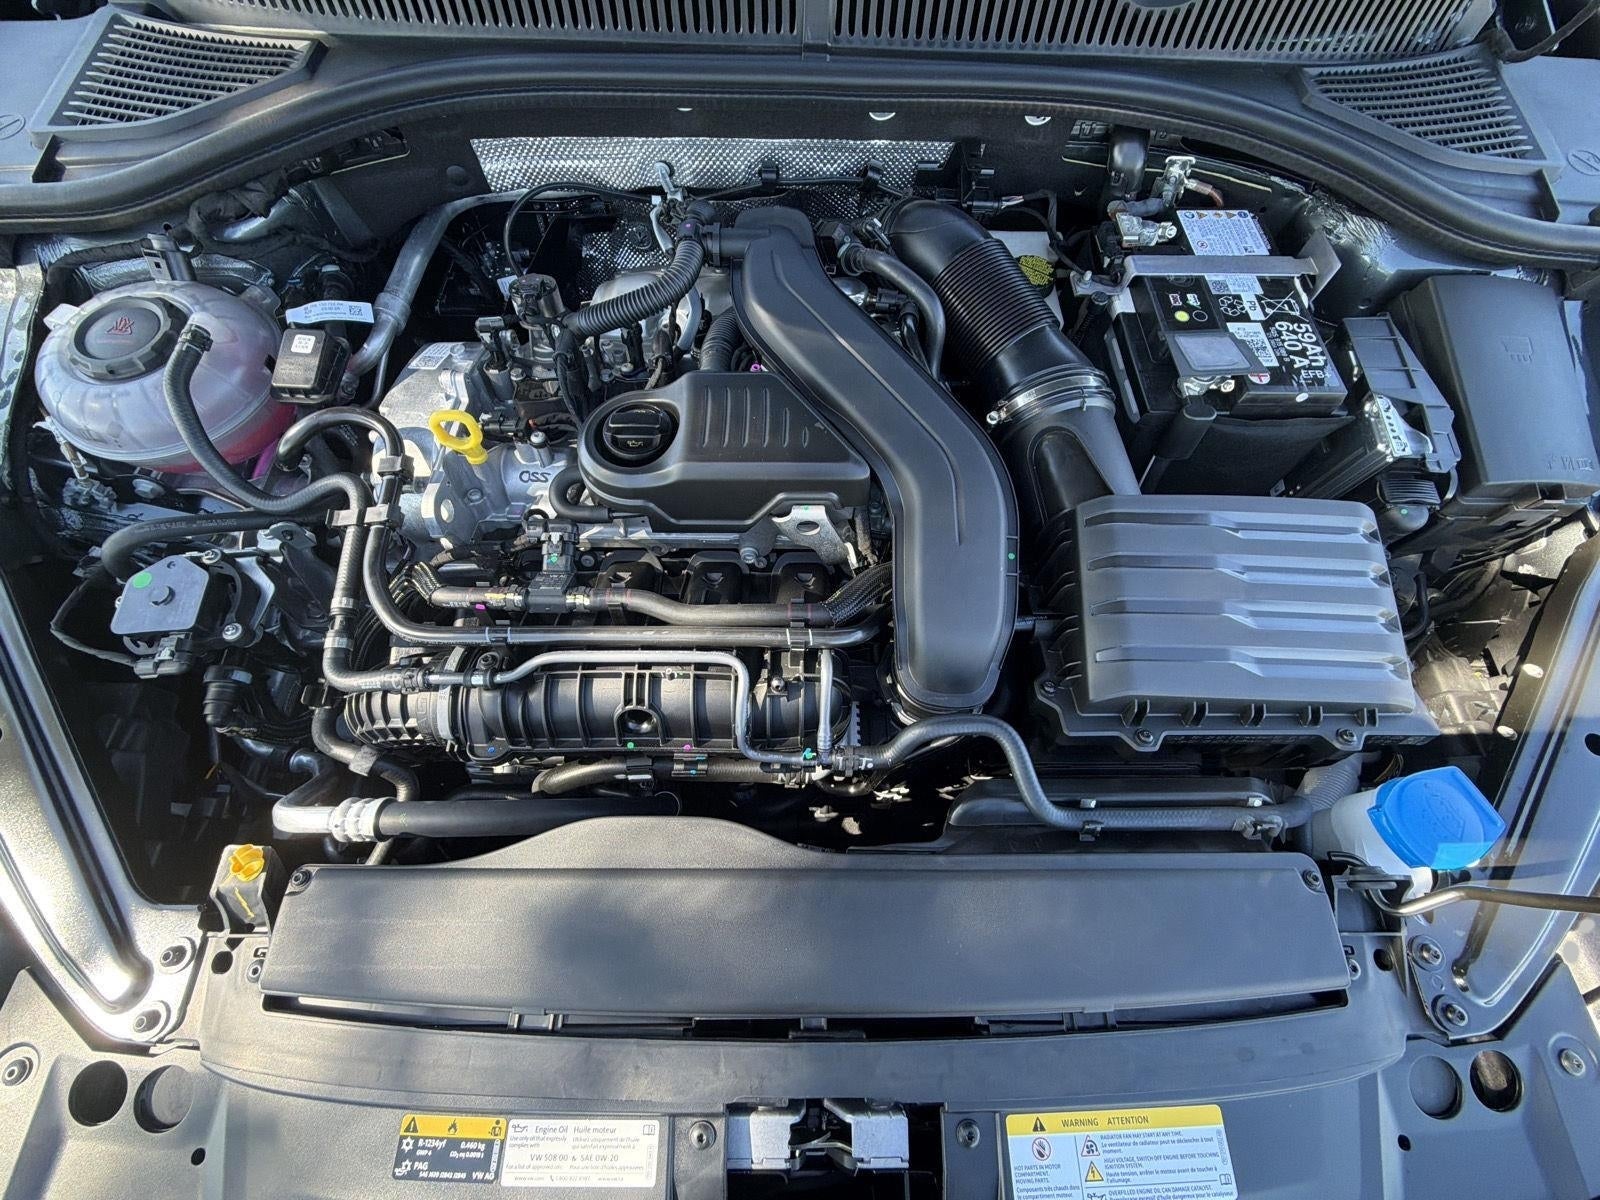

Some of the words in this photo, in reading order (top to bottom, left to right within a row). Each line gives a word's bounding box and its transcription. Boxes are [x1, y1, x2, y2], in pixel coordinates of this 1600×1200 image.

[1246, 300, 1257, 311] Pb
[1275, 321, 1303, 351] 640
[1289, 354, 1311, 368] A
[1293, 323, 1326, 366] 59Ah
[1062, 1118, 1098, 1127] WARNING
[1107, 1115, 1149, 1125] ATTENTION
[535, 1125, 558, 1135] Engine
[558, 1125, 568, 1133] Oil
[573, 1125, 590, 1133] Huile
[418, 1139, 447, 1150] R-1234yf
[478, 1142, 486, 1152] kg
[580, 1154, 593, 1162] SAE
[414, 1161, 428, 1170] PAG
